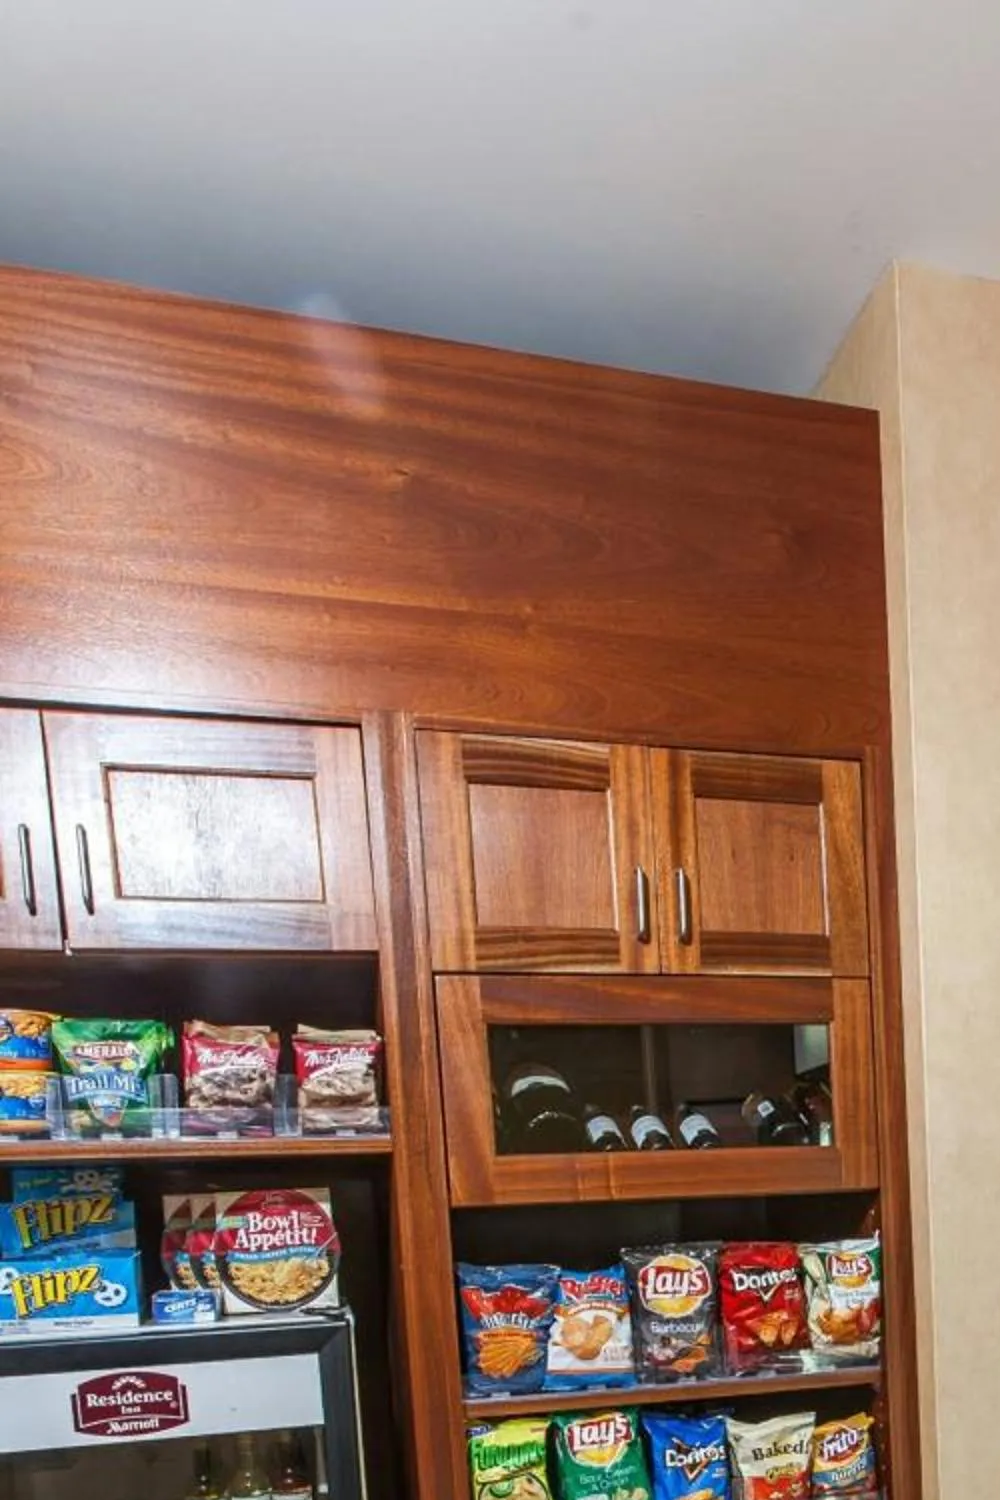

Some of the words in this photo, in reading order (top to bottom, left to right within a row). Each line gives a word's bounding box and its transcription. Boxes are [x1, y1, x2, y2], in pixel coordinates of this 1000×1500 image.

[14, 1191, 116, 1249] Flipz
[248, 1209, 301, 1233] Bowl
[10, 1262, 102, 1317] Flipz
[729, 1267, 798, 1292] Doritos
[85, 1389, 174, 1409] Residence
[106, 1417, 161, 1435] Marriott
[572, 1412, 628, 1451] Lay's
[664, 1443, 728, 1468] Doritos
